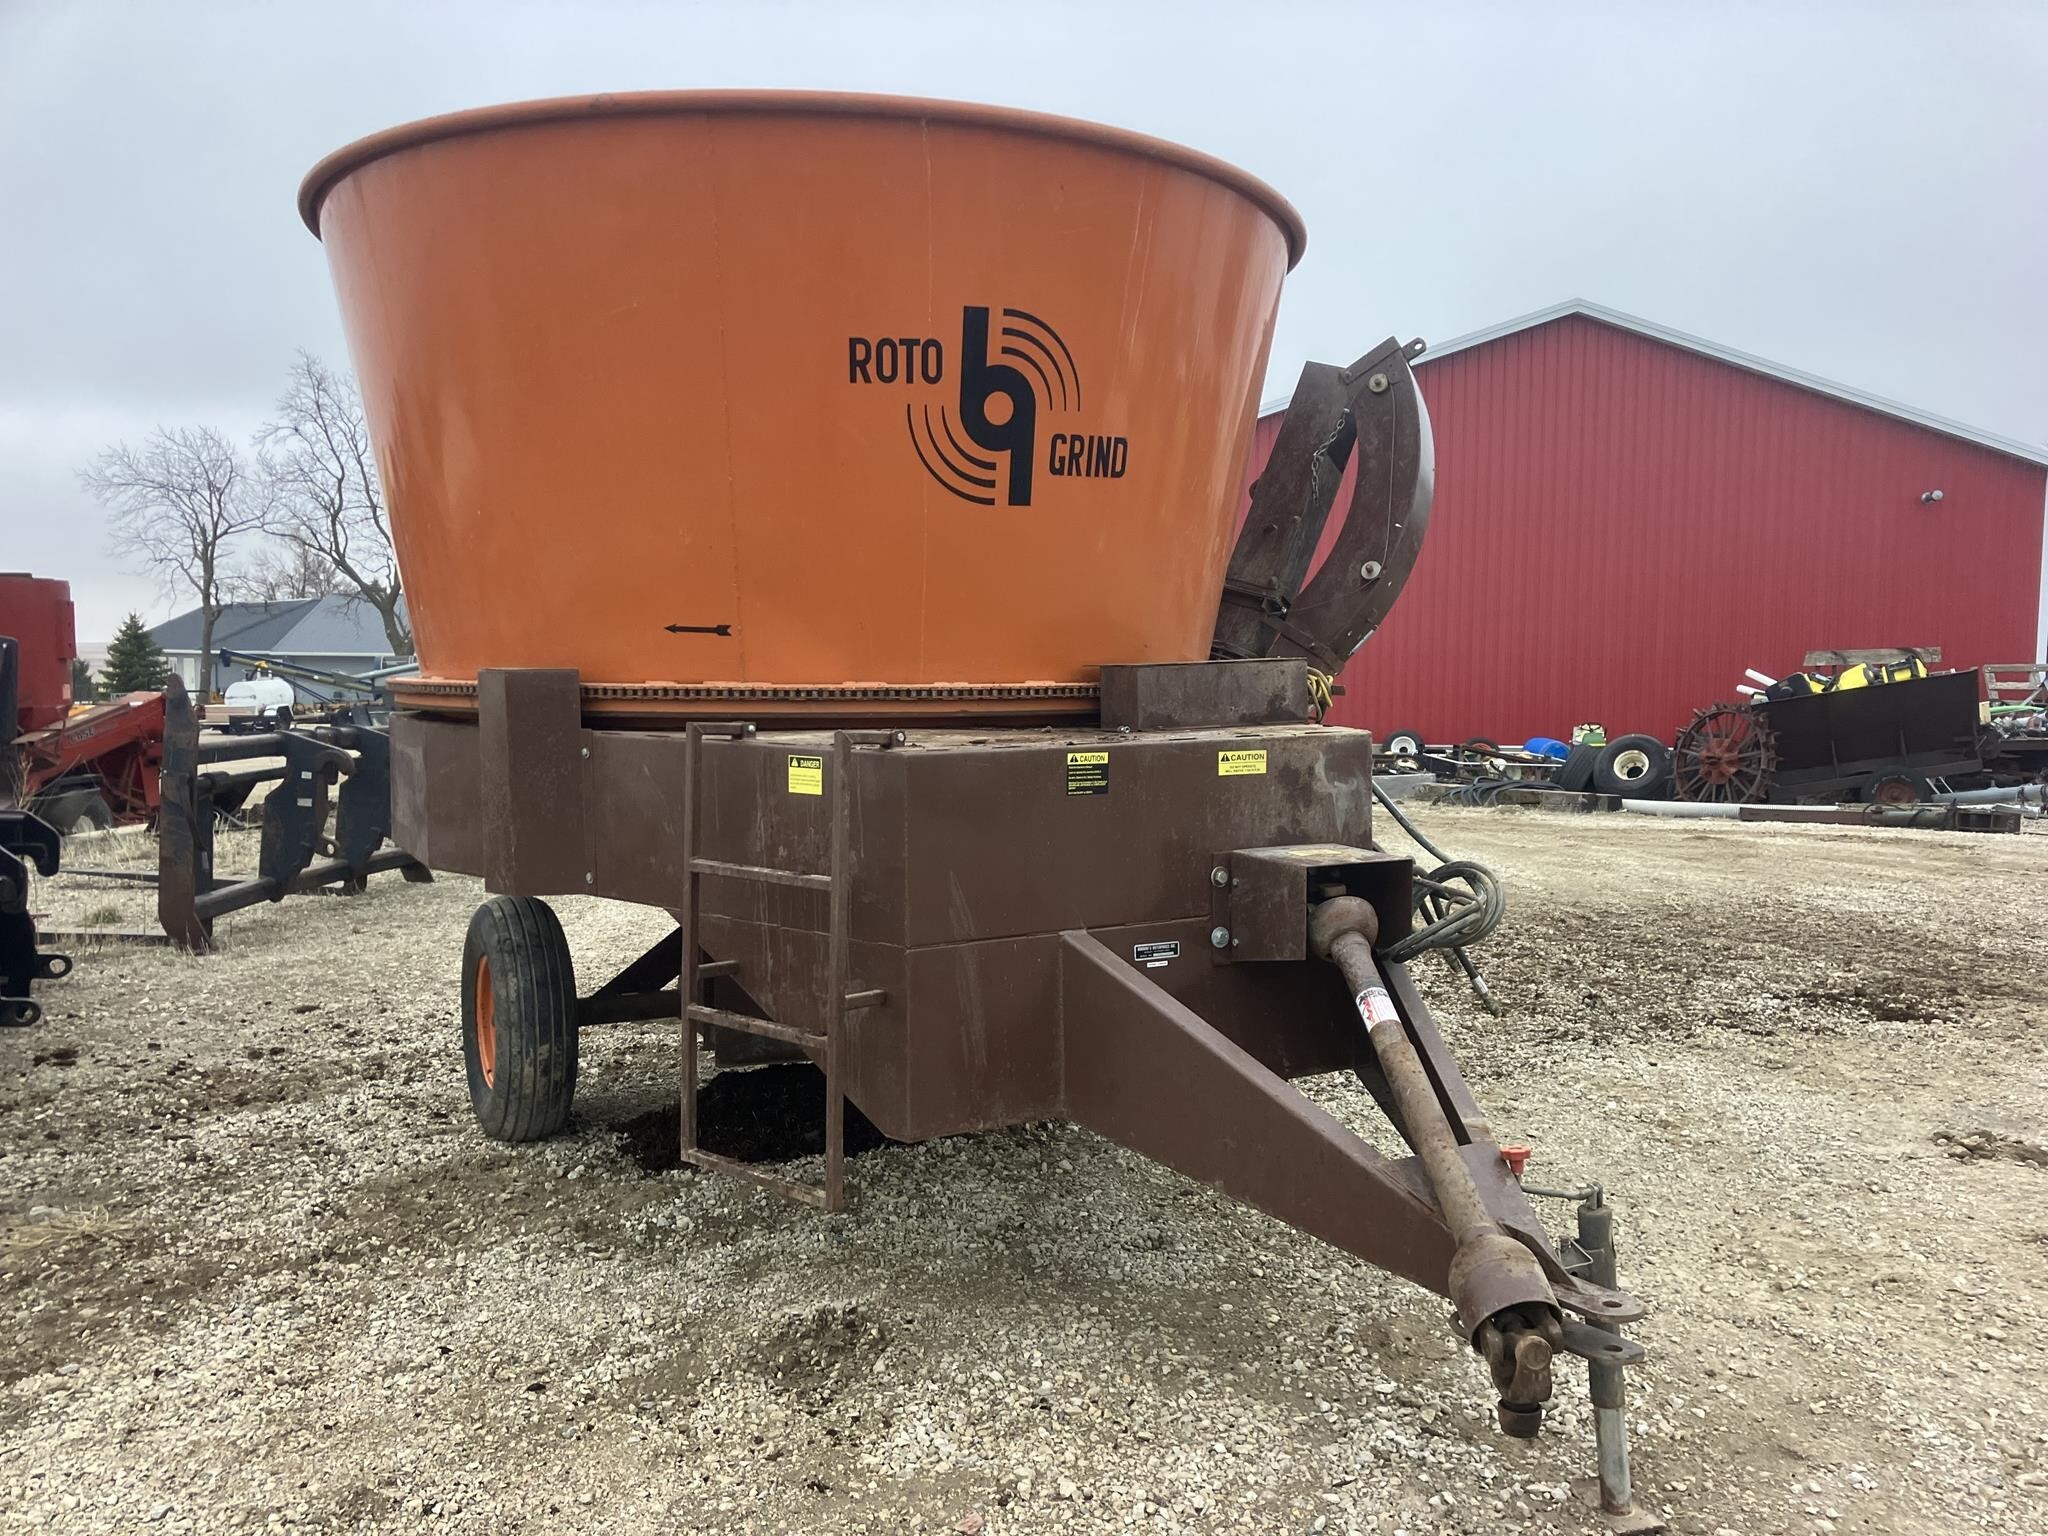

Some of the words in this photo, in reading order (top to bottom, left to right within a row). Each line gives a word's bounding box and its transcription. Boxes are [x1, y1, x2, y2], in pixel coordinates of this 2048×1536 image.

[849, 337, 943, 385] ROTO
[1049, 433, 1128, 478] GRIND
[1079, 754, 1106, 763] CAUTION
[1231, 753, 1265, 762] CAUTION
[800, 759, 820, 768] DANGER
